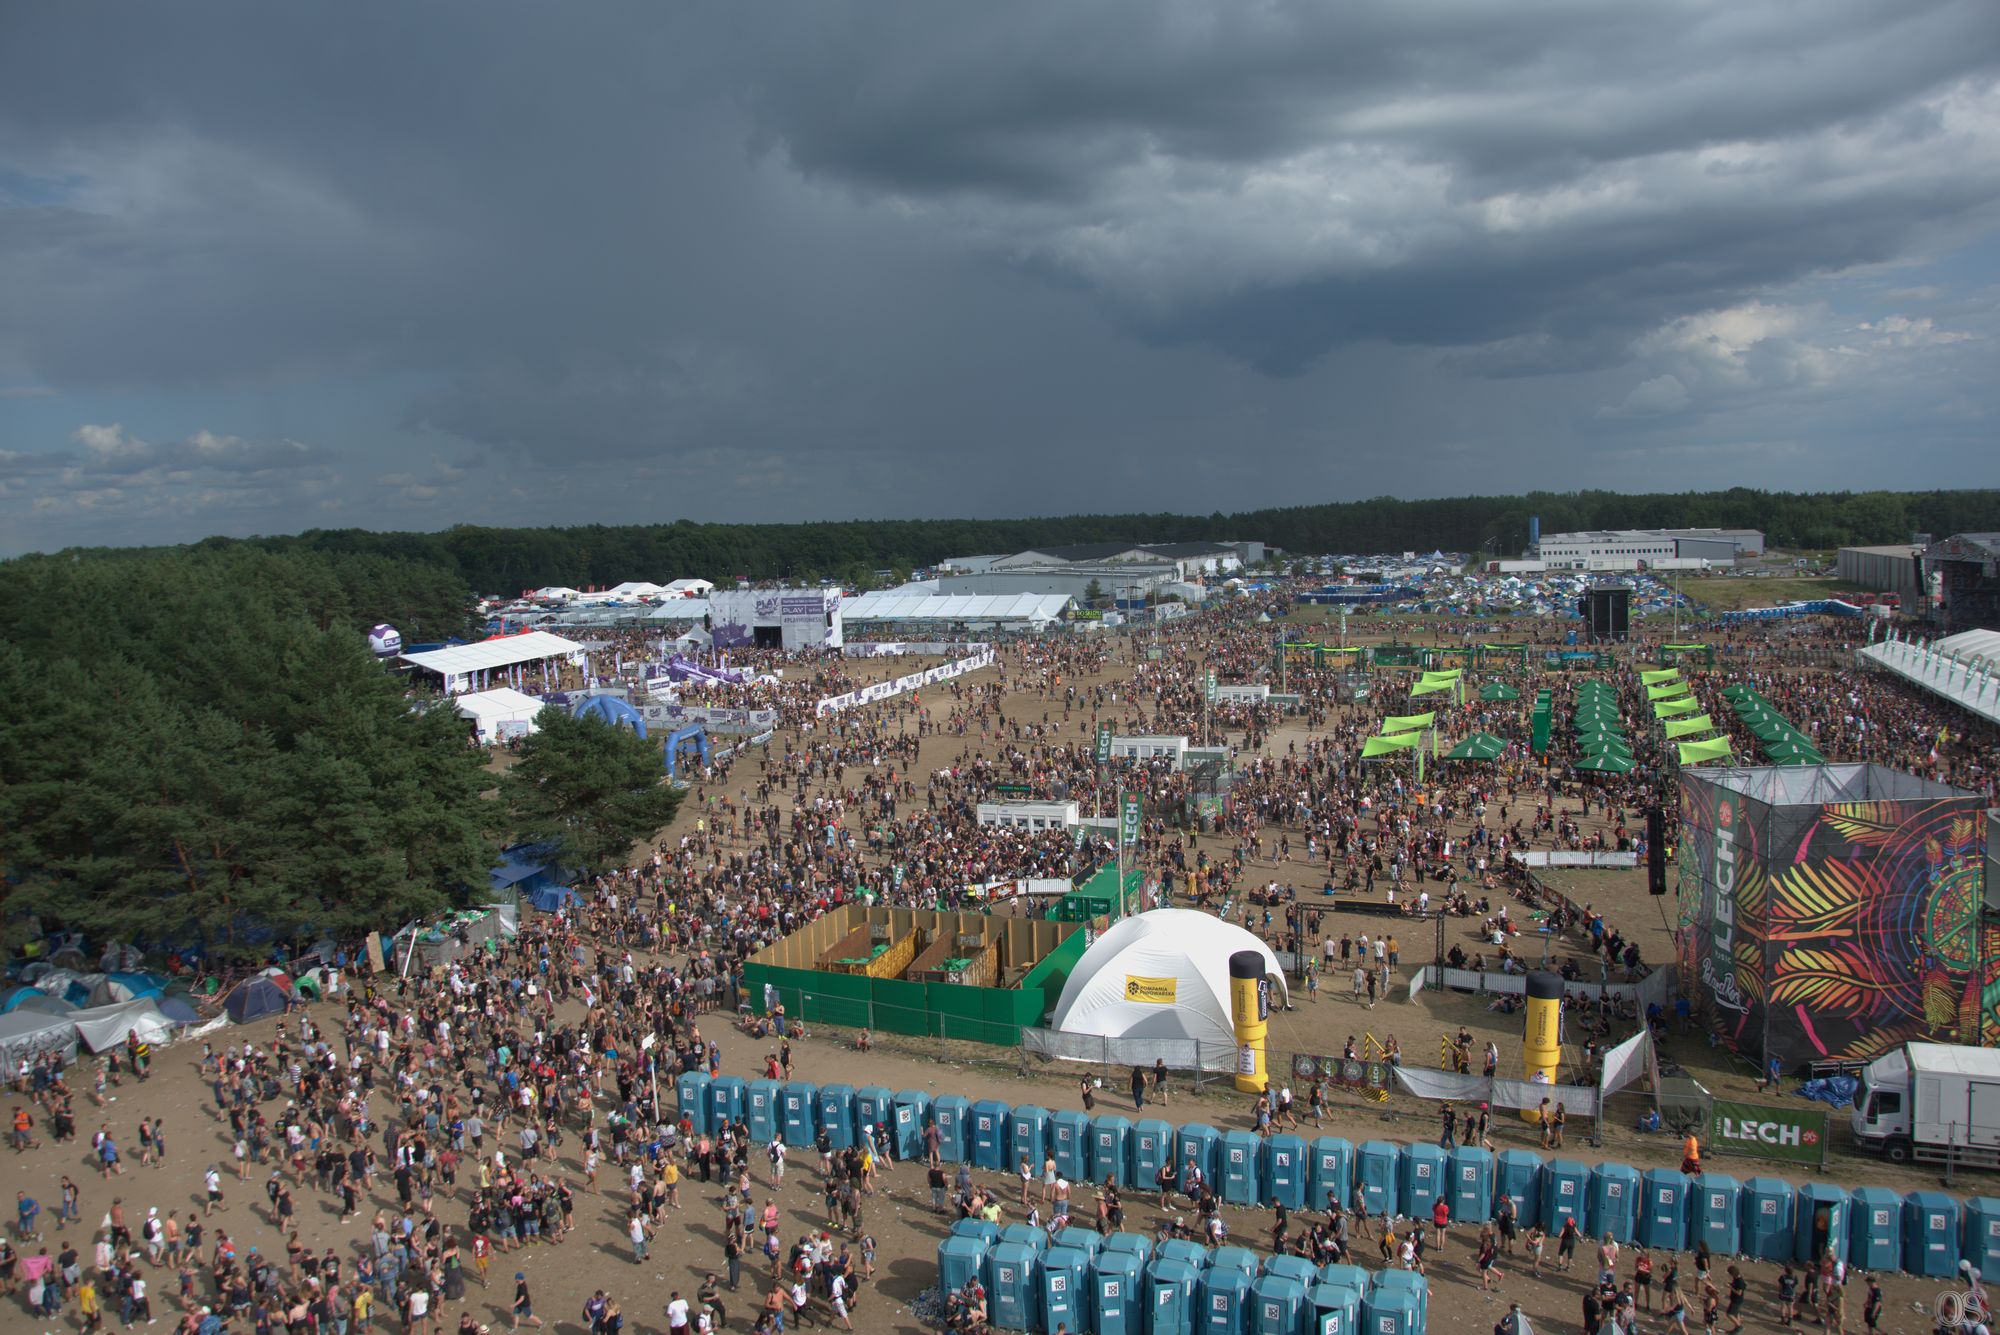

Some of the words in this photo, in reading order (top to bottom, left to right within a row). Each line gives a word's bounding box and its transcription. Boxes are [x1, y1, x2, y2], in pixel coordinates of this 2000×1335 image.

[756, 597, 778, 609] PLAY
[1208, 674, 1216, 700] LECH
[1098, 730, 1109, 763] LECH
[1075, 829, 1085, 850] LECH
[1125, 803, 1138, 847] LECH
[1715, 827, 1734, 953] LECH
[1723, 1117, 1800, 1146] LECH
